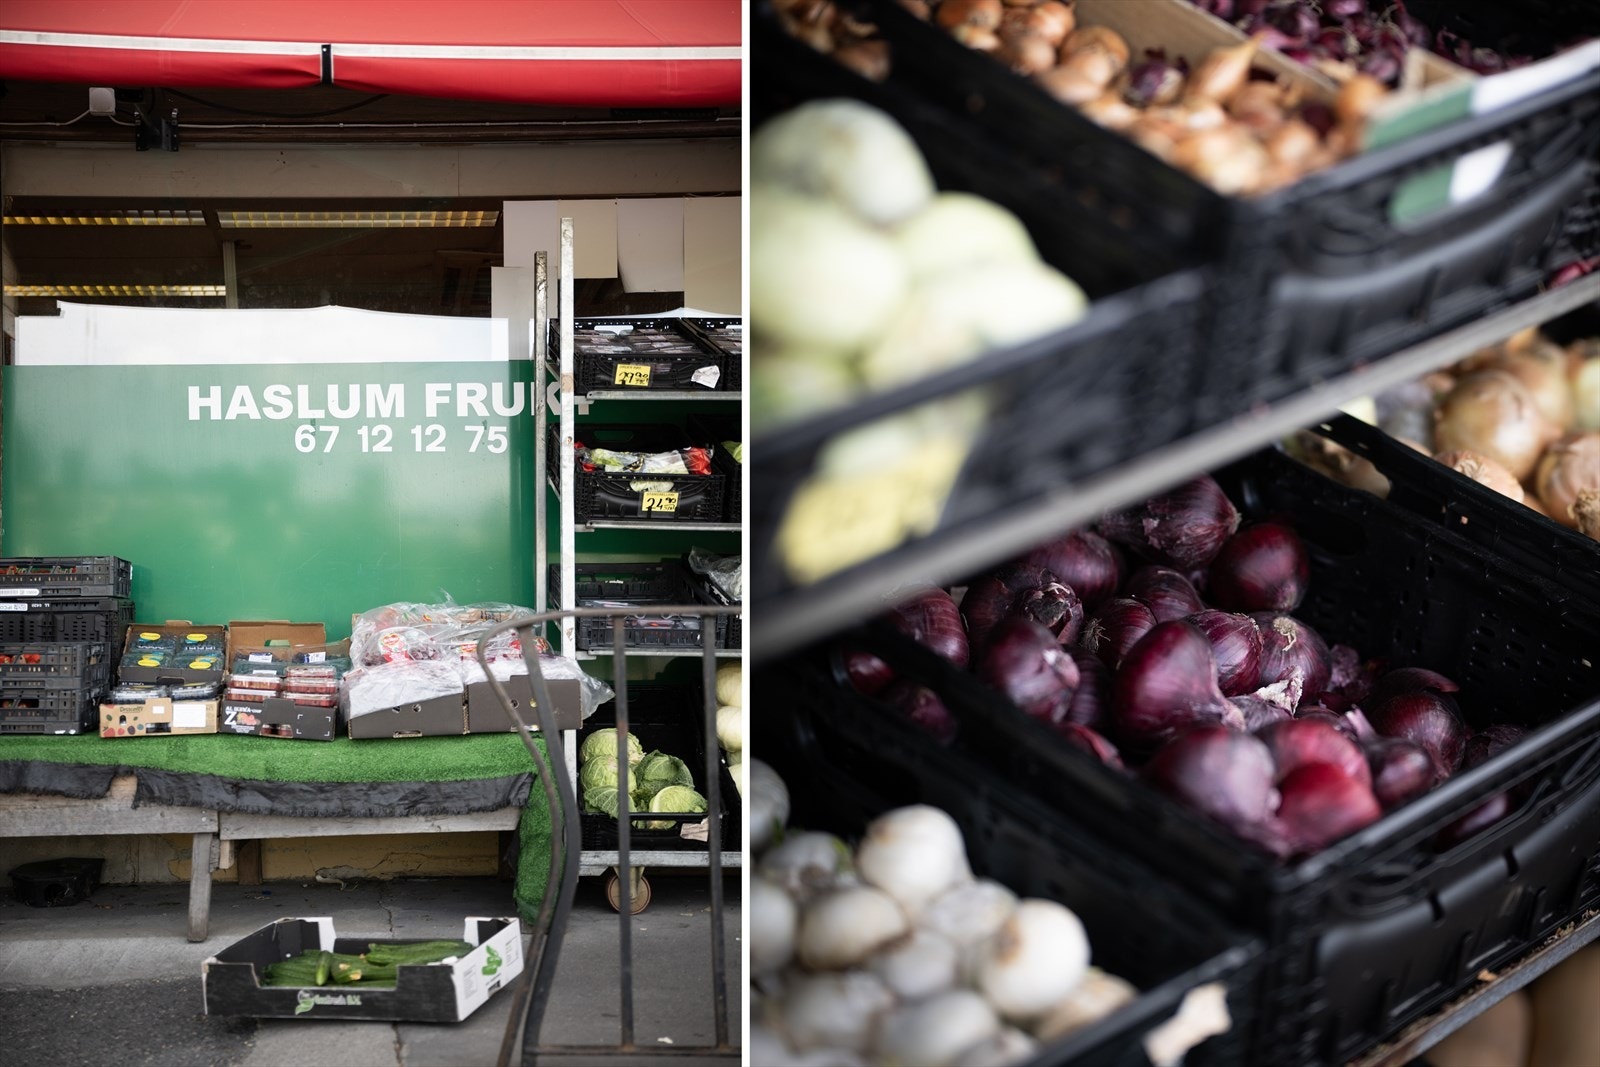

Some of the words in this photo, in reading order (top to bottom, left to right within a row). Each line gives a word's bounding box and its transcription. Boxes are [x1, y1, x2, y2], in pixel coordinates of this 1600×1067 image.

[188, 383, 405, 421] HASLUM
[294, 424, 340, 453] 67
[357, 424, 393, 453] 12
[410, 423, 447, 452] 12
[464, 424, 508, 454] 75
